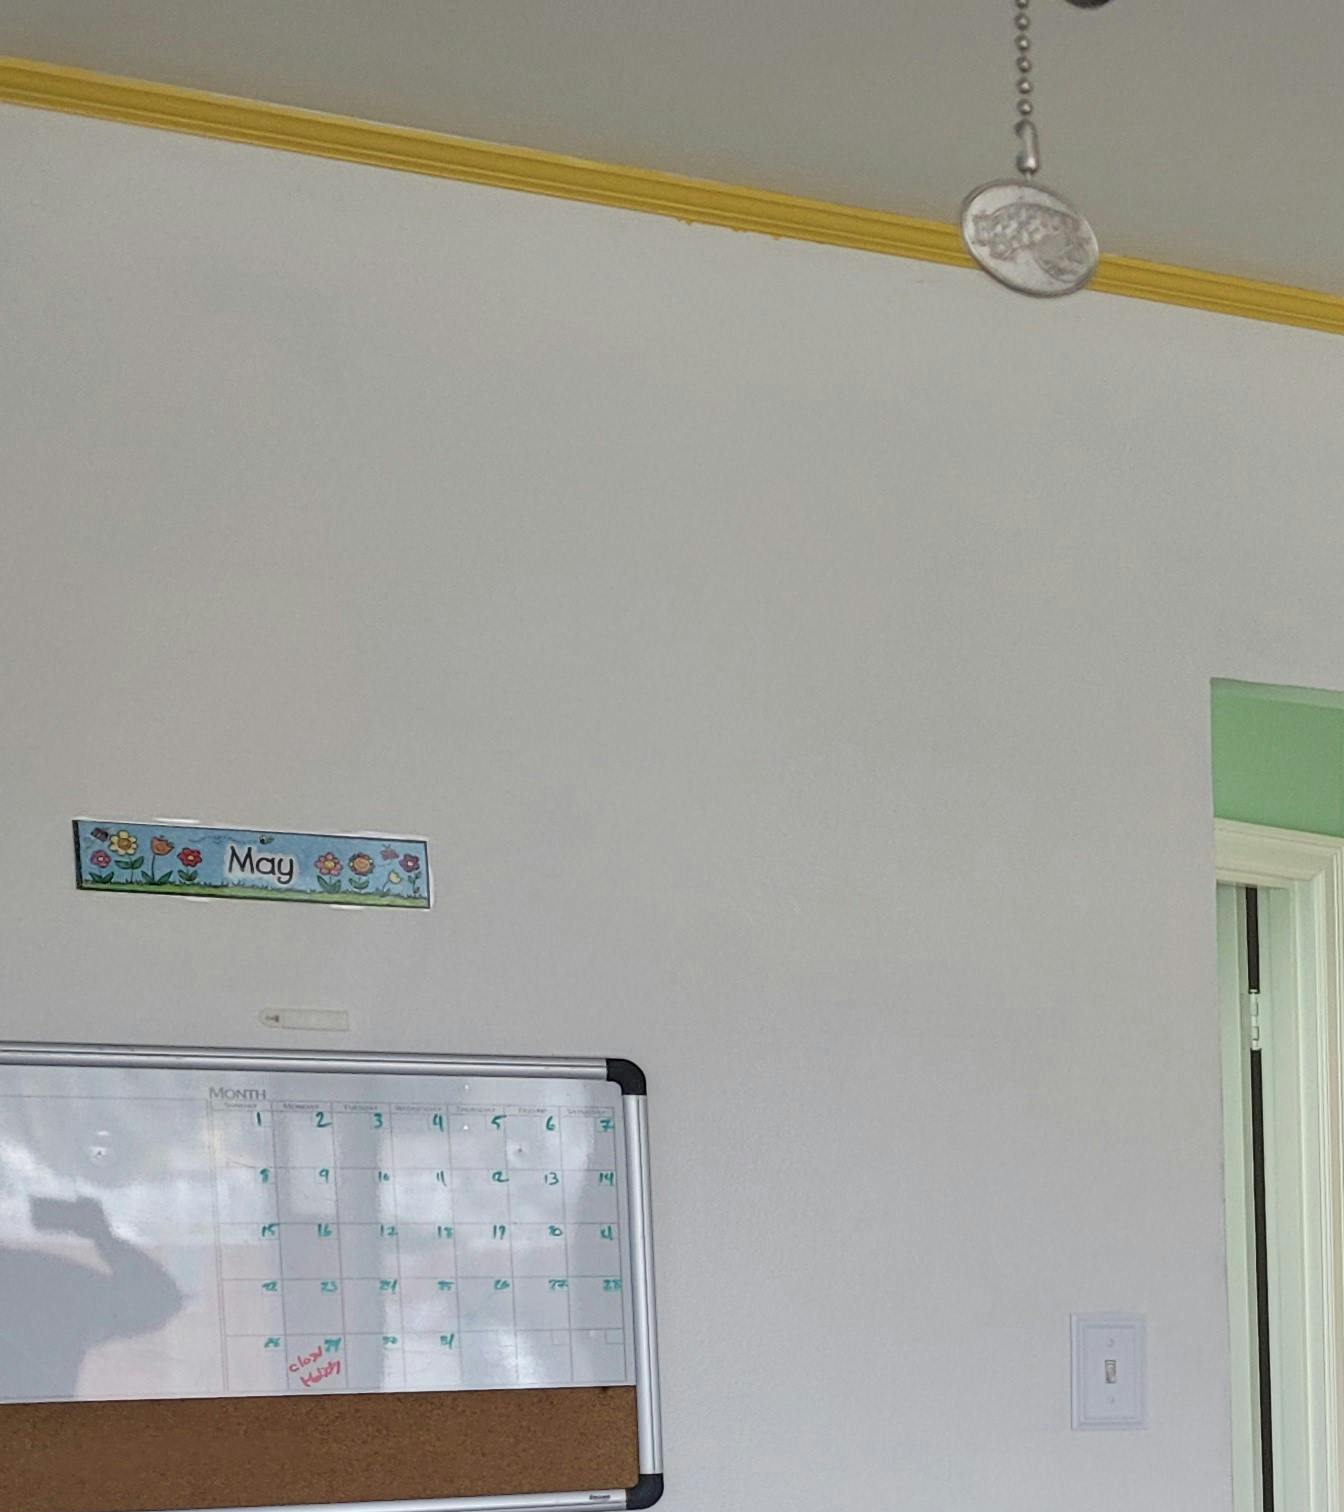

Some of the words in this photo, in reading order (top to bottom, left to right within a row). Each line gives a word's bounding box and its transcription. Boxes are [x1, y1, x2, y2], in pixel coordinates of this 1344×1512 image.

[228, 845, 294, 885] May
[209, 1087, 266, 1100] MONTH
[256, 1111, 262, 1127] 1
[315, 1111, 332, 1128] 2
[373, 1112, 383, 1128] 3
[490, 1114, 507, 1132] 5
[545, 1116, 556, 1132] 6
[600, 1119, 615, 1132] 7
[319, 1168, 330, 1184] 9
[378, 1171, 390, 1182] 10
[544, 1172, 560, 1185] 13
[599, 1171, 614, 1186] 14
[318, 1223, 333, 1238] 16
